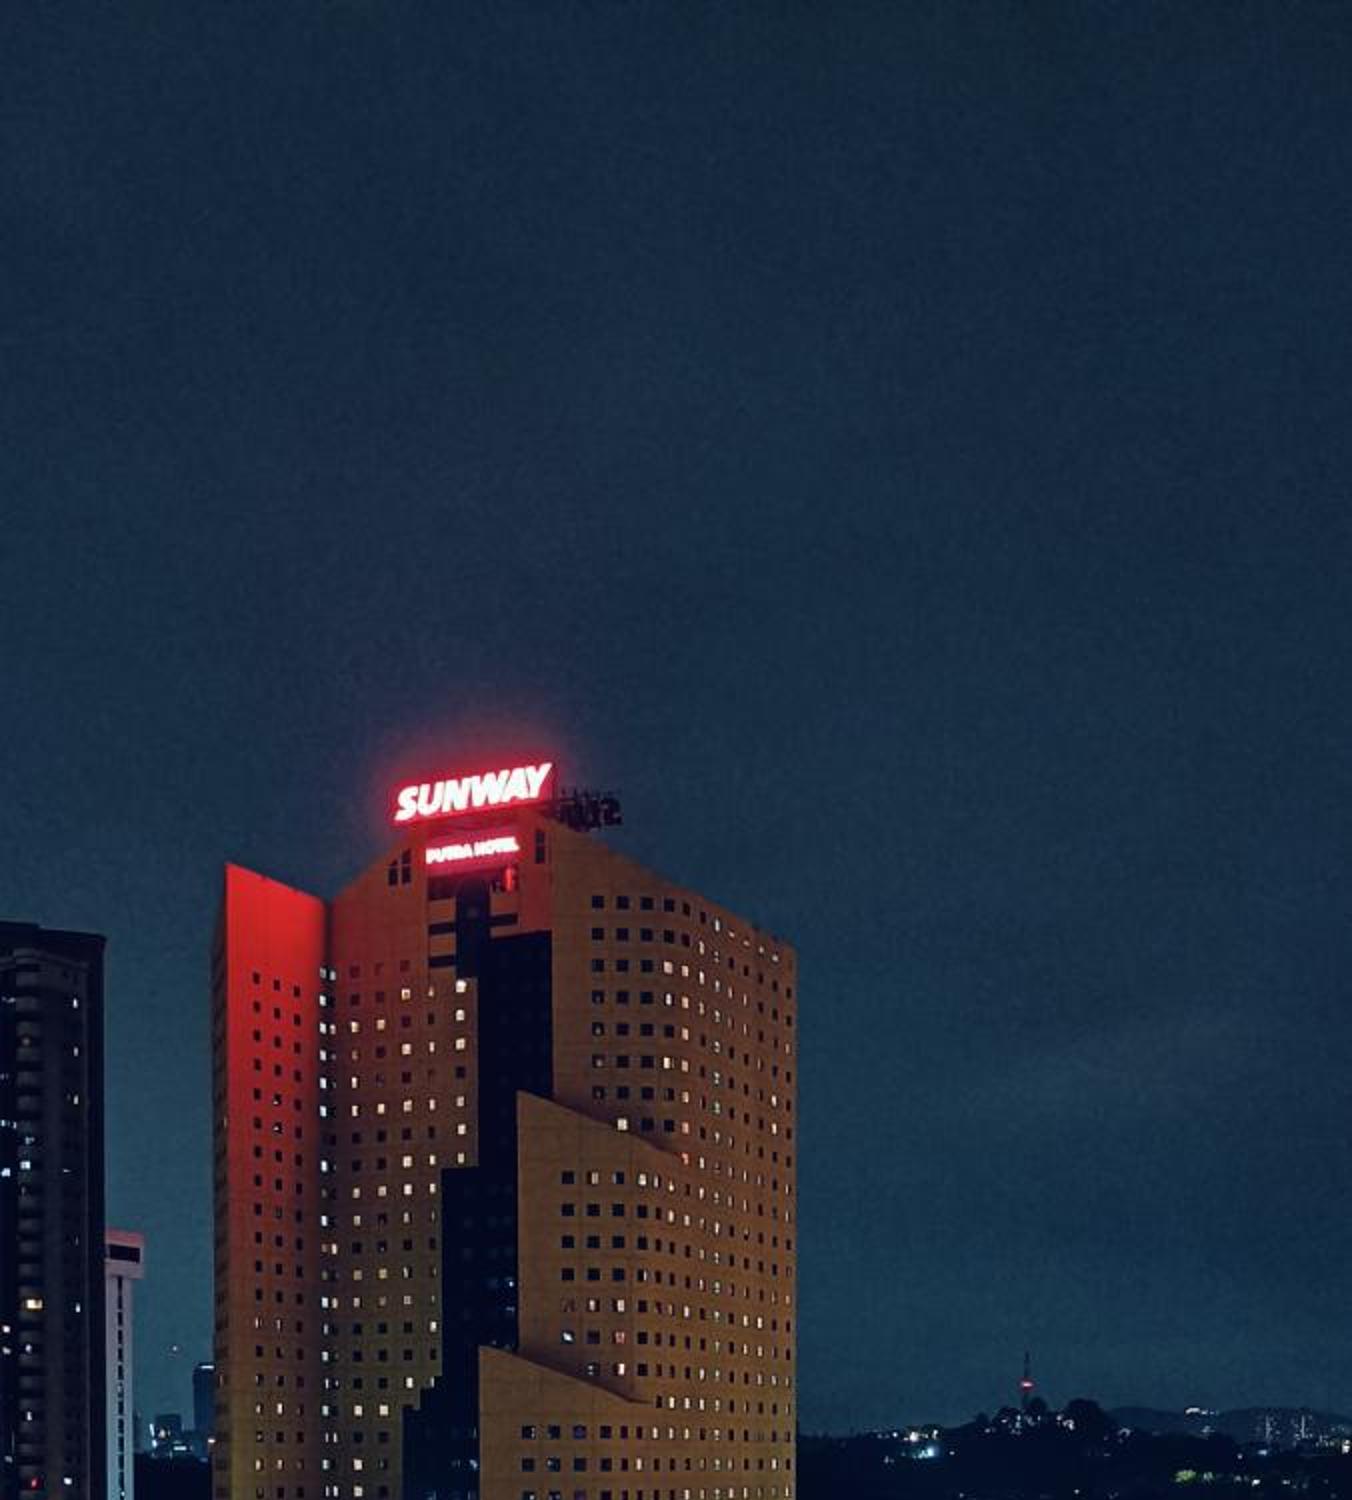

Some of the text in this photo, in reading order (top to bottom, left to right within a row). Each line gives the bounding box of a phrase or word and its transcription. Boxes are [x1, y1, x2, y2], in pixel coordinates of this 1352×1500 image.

[394, 762, 553, 821] SUNWAY
[425, 836, 519, 865] PUTRA HOTEL
